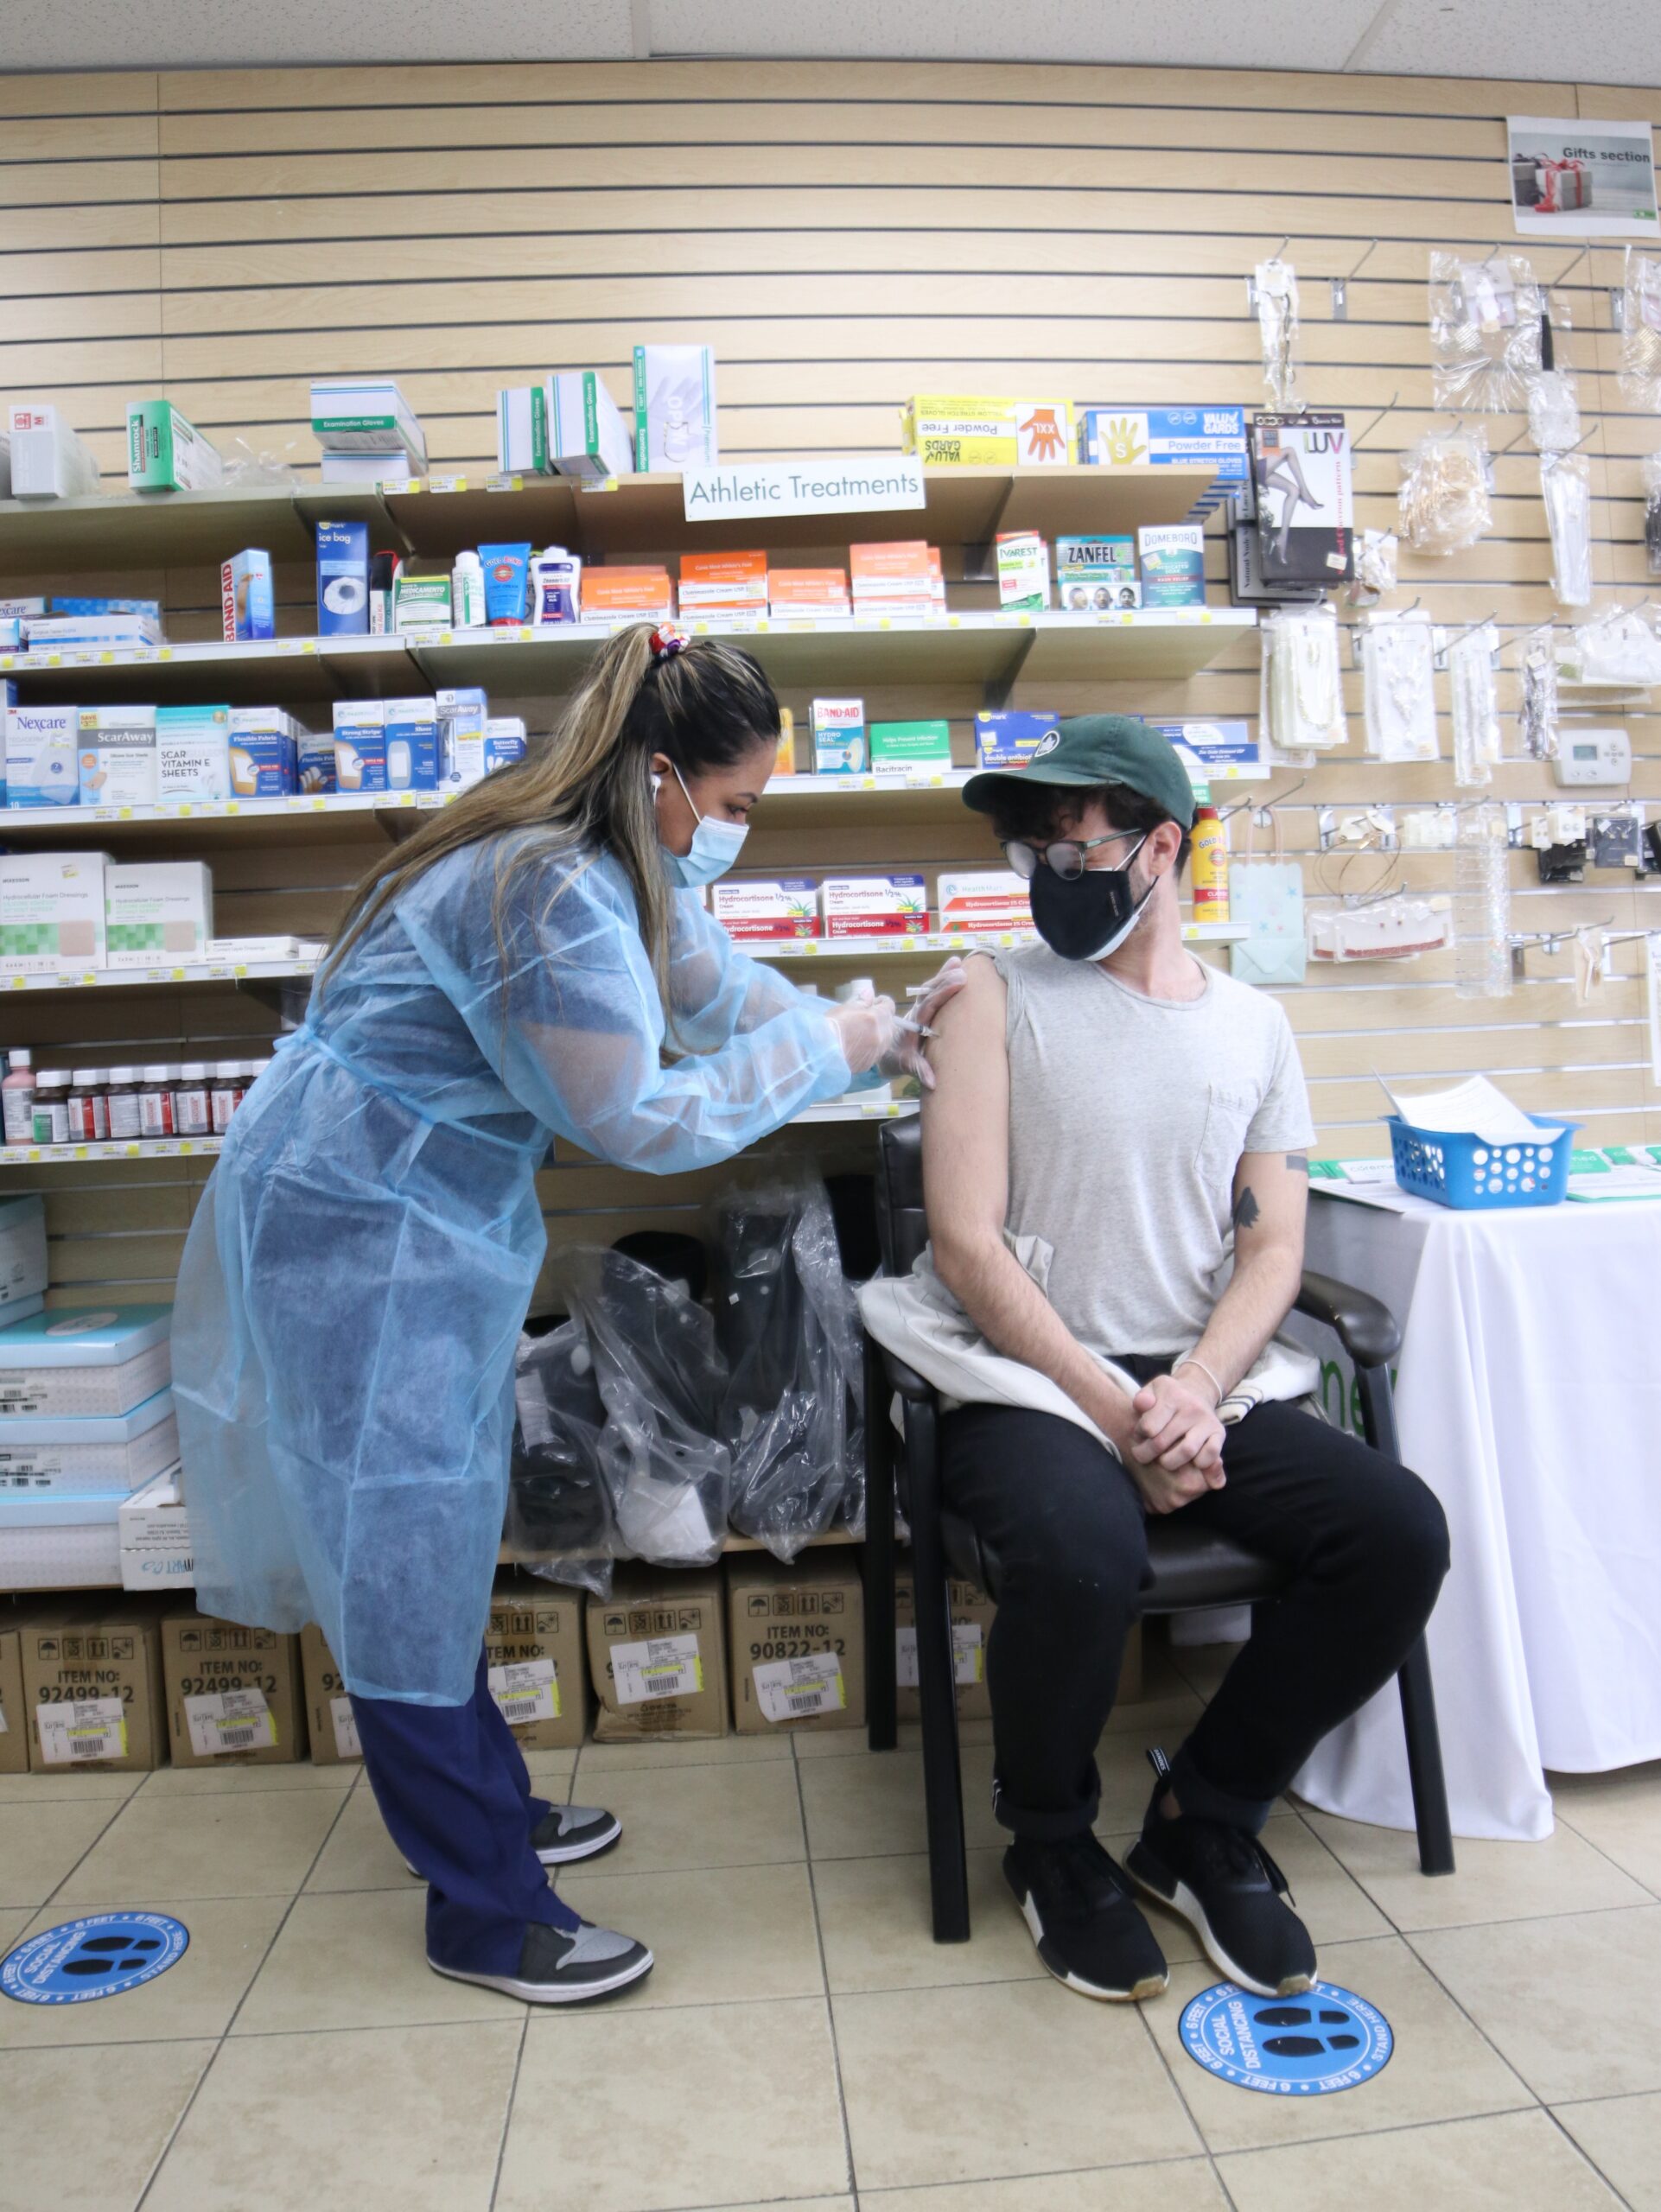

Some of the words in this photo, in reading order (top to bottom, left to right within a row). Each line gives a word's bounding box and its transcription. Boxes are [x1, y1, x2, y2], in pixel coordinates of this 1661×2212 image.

[1562, 147, 1597, 160] Gifts
[1601, 150, 1651, 163] section
[323, 420, 361, 429] Examination
[922, 423, 950, 434] Free
[952, 424, 998, 435] Powder
[1033, 423, 1055, 435] XXL
[1203, 423, 1238, 435] GARDS
[131, 420, 142, 473] Shamrock
[925, 440, 961, 451] GARDS
[1168, 441, 1211, 450] Powder
[1215, 440, 1241, 450] Free
[1302, 431, 1344, 454] LUV
[1116, 443, 1126, 459] S
[689, 475, 781, 504] Athletic
[788, 474, 920, 499] Treatments
[319, 533, 332, 542] ice
[333, 532, 351, 544] bag
[1144, 532, 1198, 547] DOMEBORO
[999, 546, 1037, 559] IVAREST
[1068, 546, 1117, 563] ZANFEL
[223, 564, 235, 642] BAND-AID
[0, 606, 27, 616] excare
[440, 705, 479, 716] ScarAway
[818, 708, 860, 718] BAND-AID
[17, 716, 67, 733] Nexcare
[98, 731, 154, 744] ScarAway
[161, 750, 187, 760] SCAR
[162, 760, 201, 768] VITAMIN
[205, 759, 210, 767] E
[875, 765, 913, 773] Bacitracin
[162, 768, 199, 778] SHEETS
[1199, 836, 1217, 849] GOLD
[718, 895, 774, 904] Hydrocortisone
[829, 890, 883, 899] Hydrocortisone
[832, 920, 884, 930] Hydrocortisone
[767, 1626, 802, 1639] ITEM
[805, 1624, 830, 1637] NO:
[487, 1645, 516, 1658] TEM
[519, 1644, 544, 1658] NO:
[750, 1640, 846, 1660] 90822-12
[200, 1662, 234, 1675] ITEM
[238, 1661, 263, 1674] NO:
[58, 1670, 92, 1683] ITEM
[95, 1669, 120, 1682] NO:
[181, 1676, 277, 1694] 92499-12
[39, 1686, 135, 1703] 92499-12
[87, 1916, 116, 1925] FEET
[144, 1916, 168, 1926] FEET
[29, 1932, 54, 1949] FEET
[24, 1942, 61, 1974] SOCIAL
[32, 1931, 86, 1984] DISTANCING
[140, 1952, 178, 1980] STAND
[173, 1930, 183, 1949] HERE
[3, 1964, 17, 1979] FEET
[15, 1989, 39, 2000] FEET
[71, 1990, 104, 2001] FEET
[1215, 1988, 1226, 1997] 6
[1187, 2003, 1207, 2022] FEET
[1346, 1998, 1380, 2025] HERE
[1212, 2014, 1235, 2056] SOCIAL
[1228, 2000, 1262, 2069] DISTANCING
[1371, 2025, 1389, 2062] STAND
[1190, 2043, 1212, 2063] FEET
[1210, 2061, 1224, 2069] 6
[1348, 2071, 1362, 2080] 6
[1241, 2075, 1277, 2091] FEET
[1281, 2082, 1291, 2092] 6
[1319, 2075, 1352, 2091] FEET
